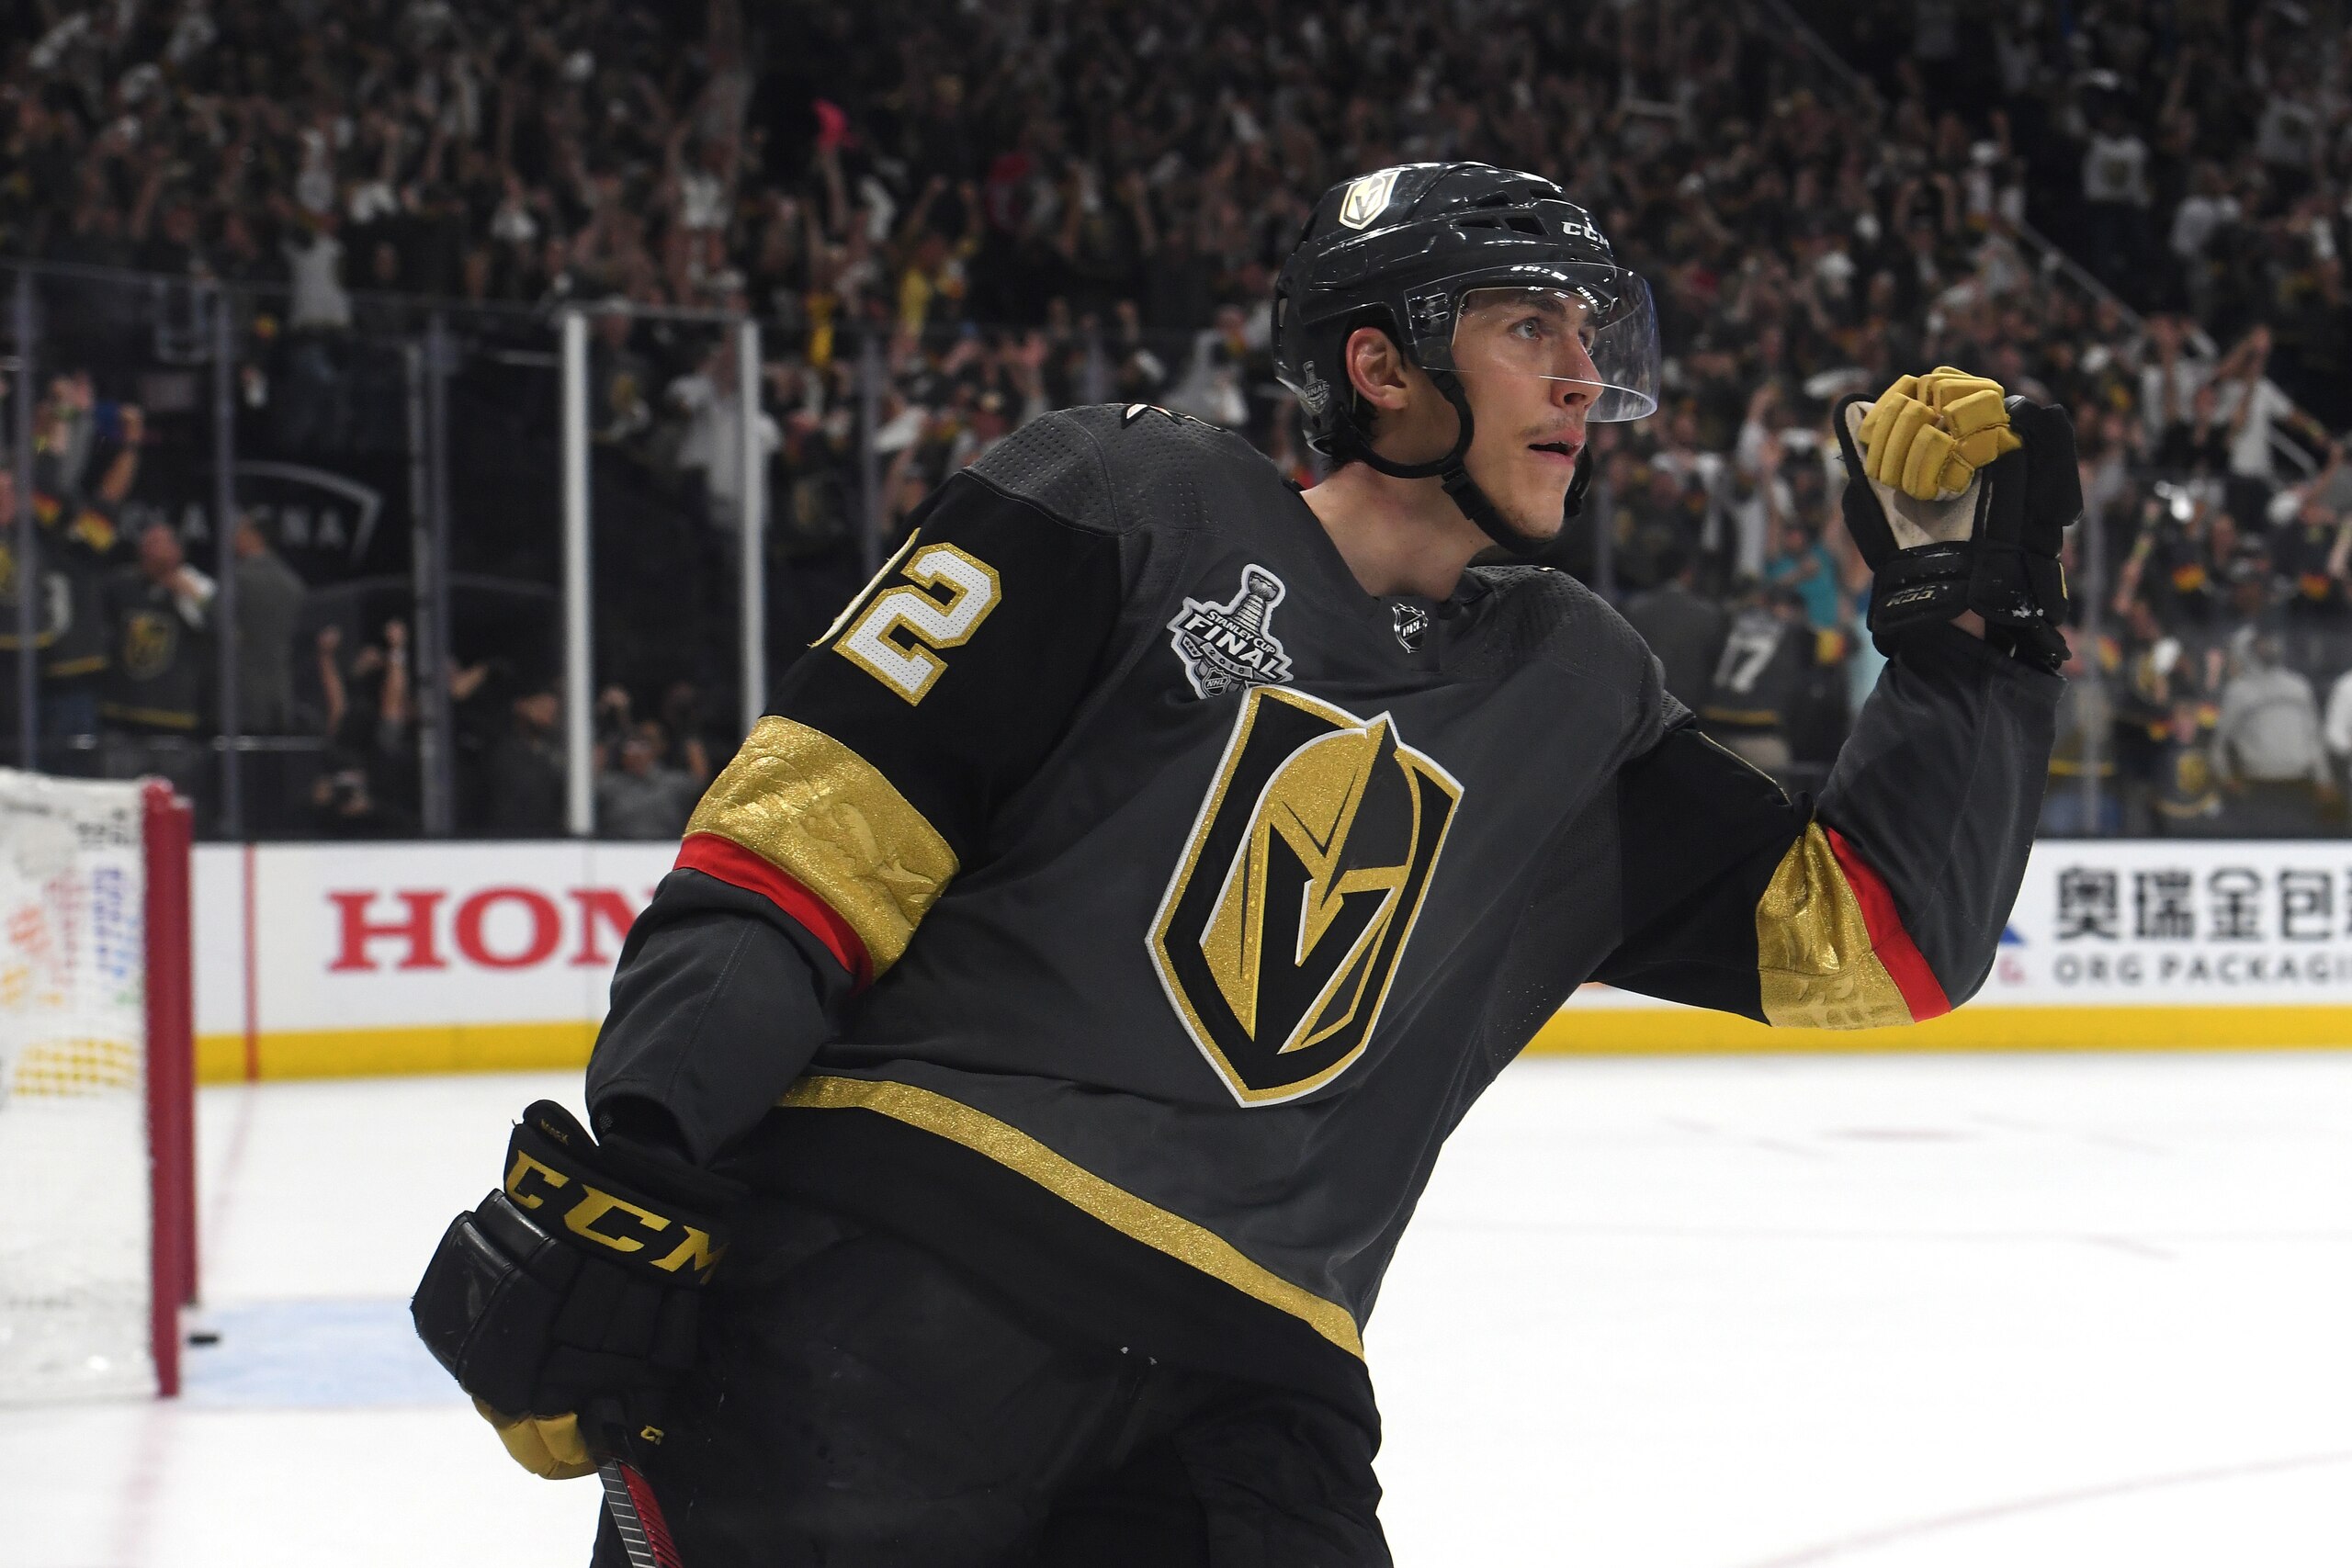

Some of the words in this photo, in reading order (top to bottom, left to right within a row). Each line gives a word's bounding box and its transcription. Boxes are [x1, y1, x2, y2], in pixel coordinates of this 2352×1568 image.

[808, 527, 1002, 706] 2
[1207, 611, 1254, 641] STANLEY
[1252, 638, 1276, 654] CUP
[1184, 613, 1279, 680] FINAL
[1208, 649, 1245, 675] 2018
[1206, 678, 1226, 688] NHL
[2055, 866, 2352, 941] 奥瑞金包
[2054, 953, 2143, 985] ORG
[505, 1149, 729, 1285] CCM
